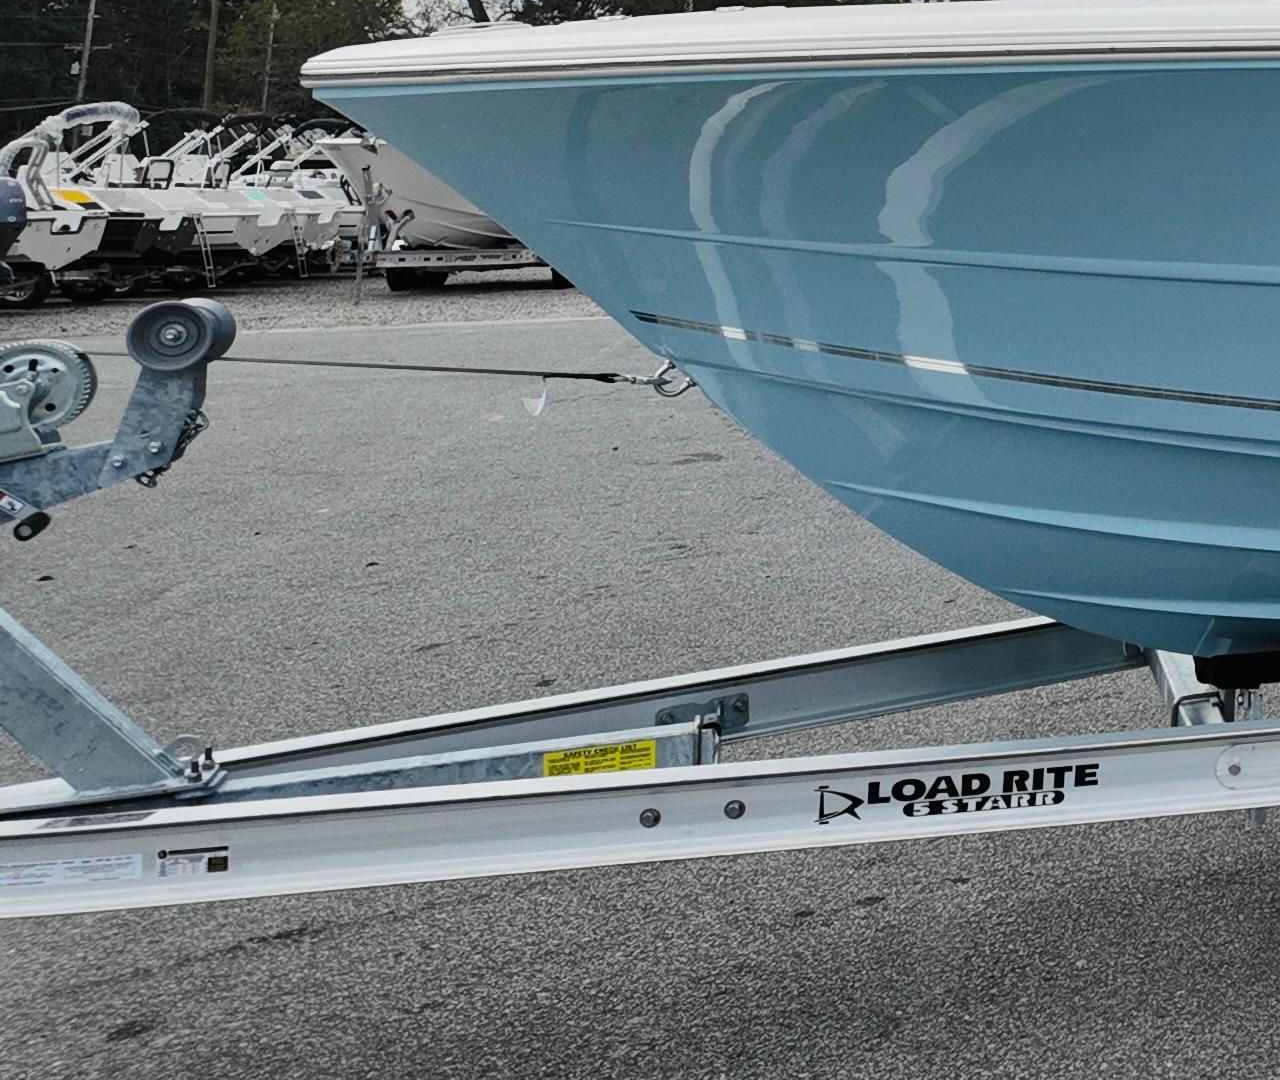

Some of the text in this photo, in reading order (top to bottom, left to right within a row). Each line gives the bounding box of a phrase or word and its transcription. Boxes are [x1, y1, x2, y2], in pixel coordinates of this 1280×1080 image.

[867, 763, 1100, 805] LOAD RITE
[912, 801, 931, 816] 5
